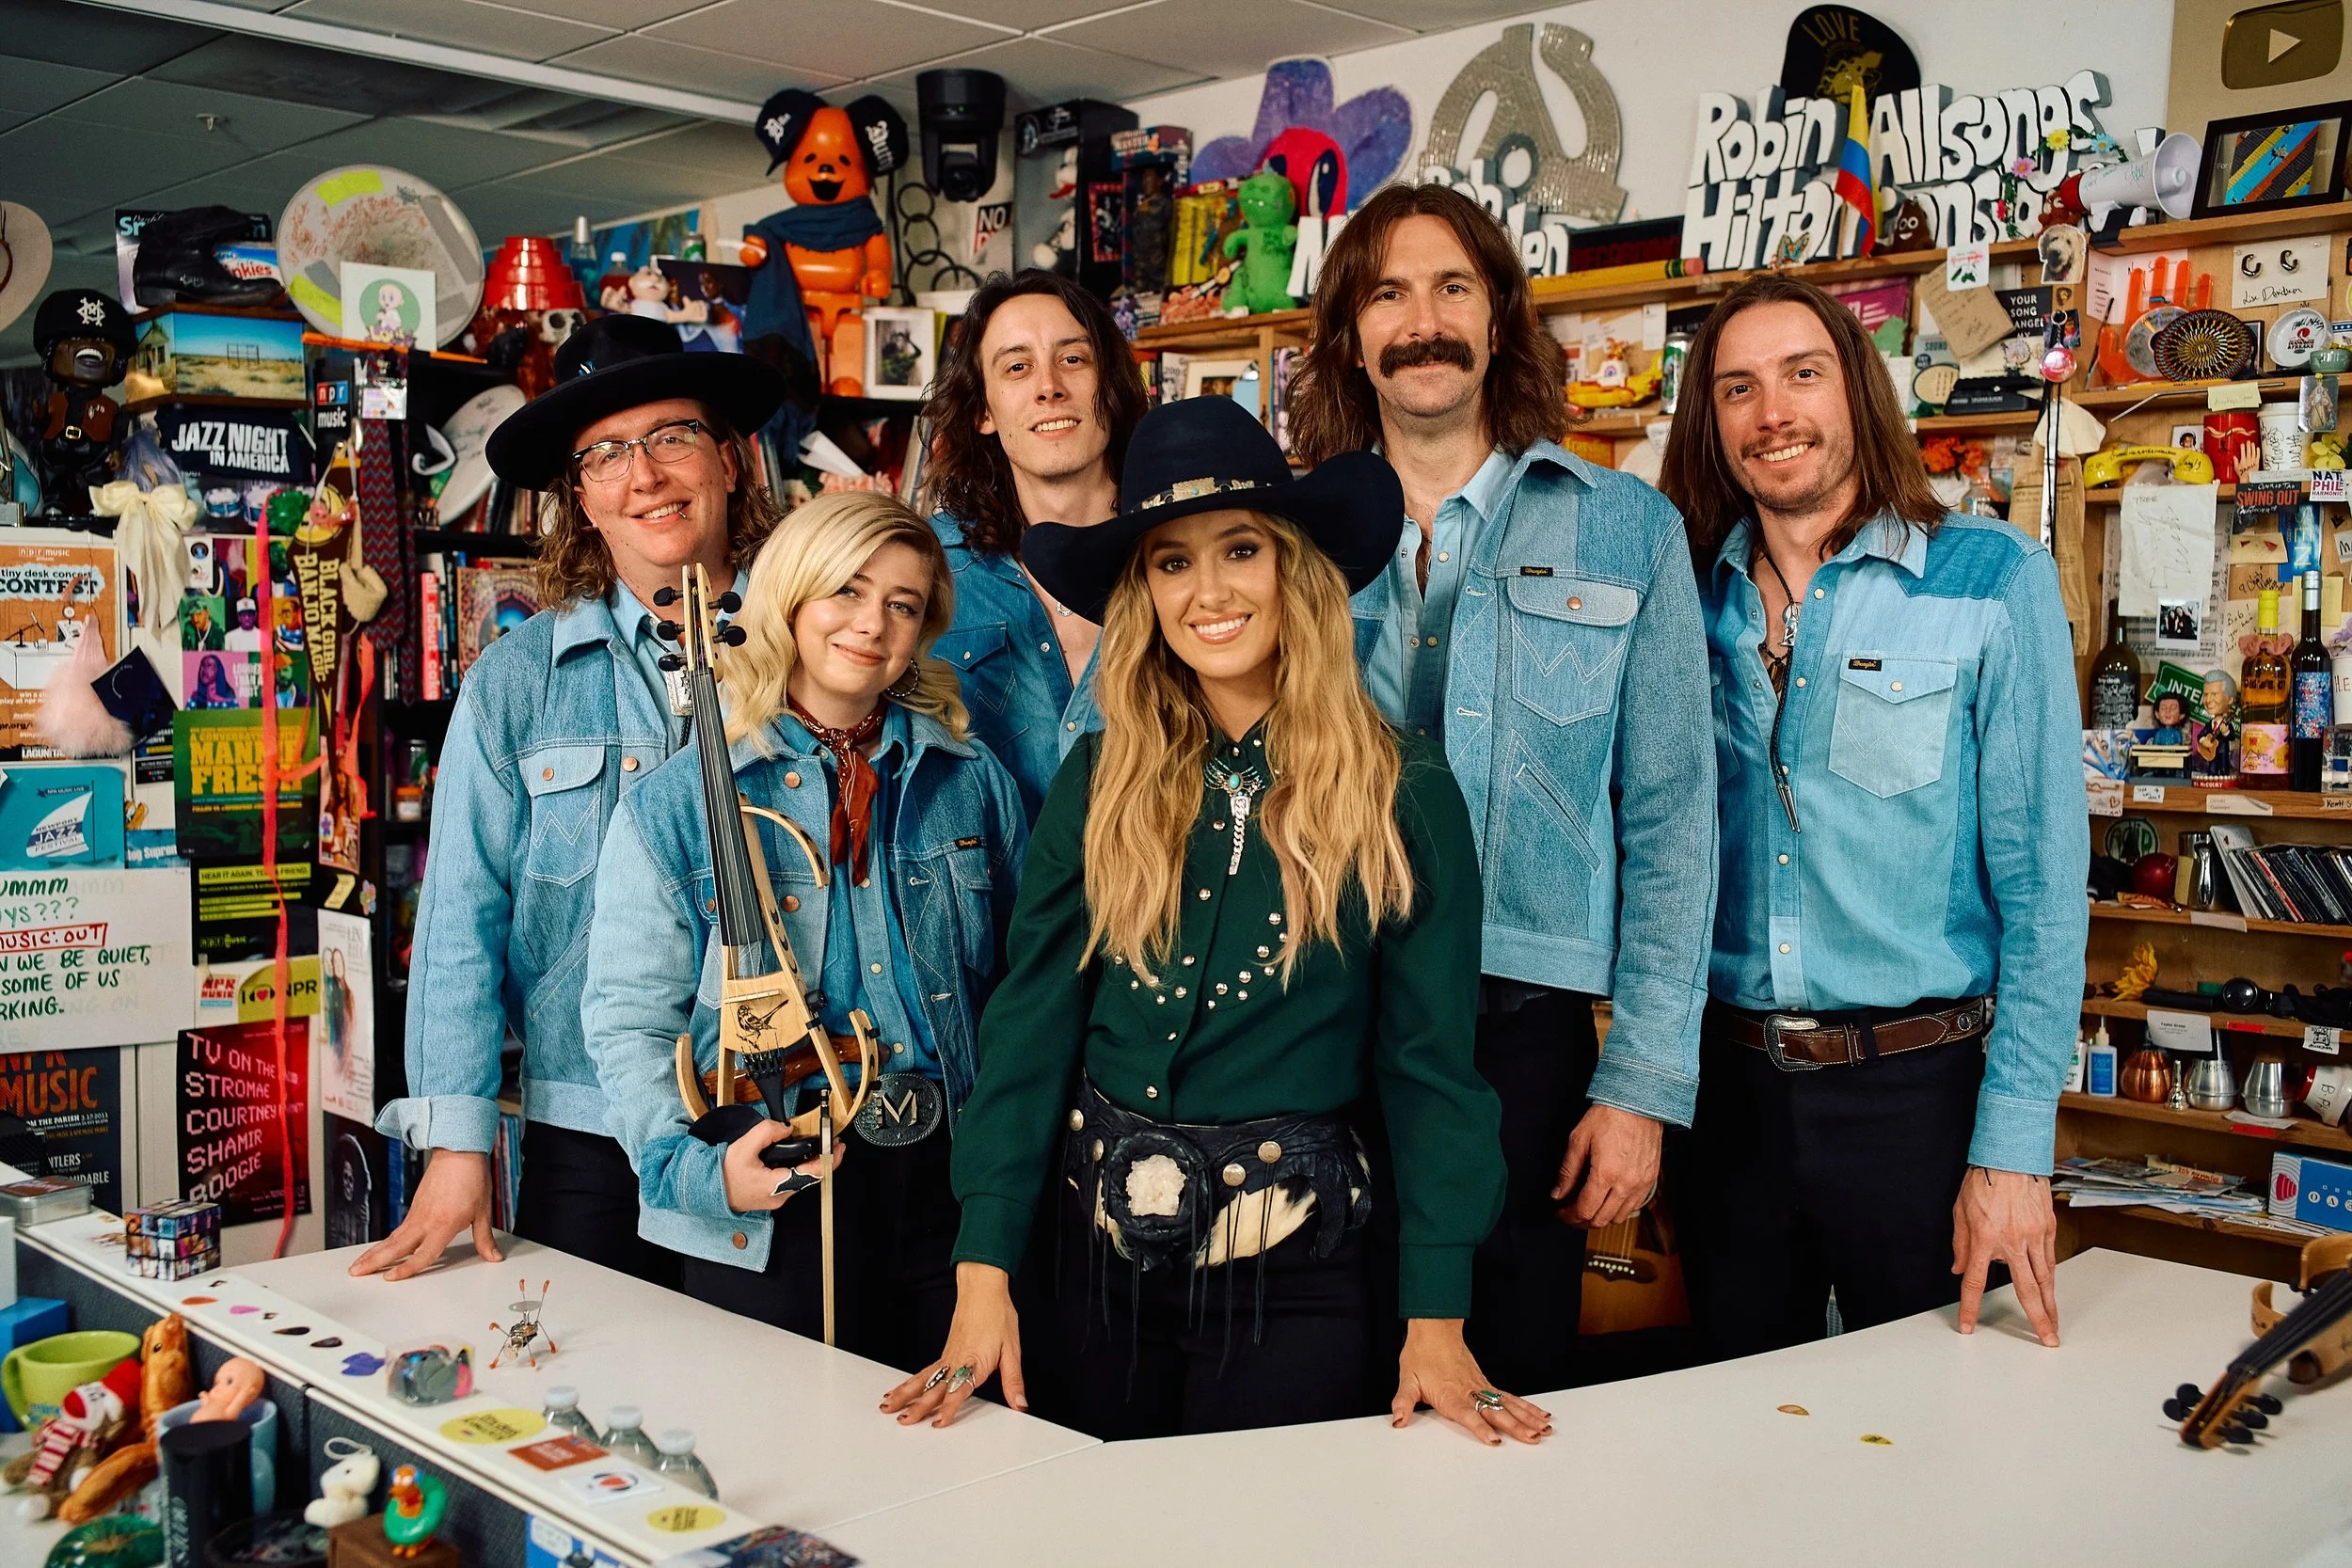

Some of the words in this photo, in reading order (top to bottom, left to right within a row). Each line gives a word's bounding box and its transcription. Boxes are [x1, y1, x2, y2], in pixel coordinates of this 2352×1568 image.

[1801, 11, 1861, 47] LOVE
[1691, 87, 1844, 185] Robin
[1873, 69, 2109, 192] Allsongs
[979, 207, 1006, 231] NO
[2010, 294, 2038, 306] YOUR
[2010, 307, 2038, 318] SONG
[318, 382, 347, 404] npr
[318, 406, 346, 429] music
[171, 421, 225, 452] JAZZ
[229, 422, 289, 457] NIGHT
[210, 450, 225, 467] IN
[227, 451, 291, 473] AMERICA
[2312, 471, 2341, 481] NAT
[2312, 482, 2344, 491] PHIL
[2236, 490, 2274, 506] SWING
[2277, 490, 2299, 506] OUT
[45, 548, 70, 557] music
[1, 569, 21, 579] tiny
[24, 570, 49, 578] desk
[293, 553, 320, 624] BANJO
[319, 557, 341, 630] BLACK
[306, 624, 327, 684] MAGIC
[321, 631, 336, 674] GIRL
[191, 763, 303, 795] FRE
[35, 825, 77, 845] JAZZ
[36, 817, 78, 832] NEWPORT
[0, 895, 80, 928] YS???
[64, 925, 103, 944] OUT
[17, 953, 46, 973] WE
[60, 949, 85, 969] BE
[97, 944, 152, 967] QUIET,
[65, 972, 90, 990] OF
[98, 969, 121, 989] US
[285, 979, 318, 997] NPR
[186, 1032, 221, 1065] TV
[229, 1049, 252, 1072] ON
[256, 1058, 276, 1080] THE
[0, 1066, 99, 1117] MUSIC
[185, 1071, 271, 1099] STROMAE
[39, 1118, 53, 1127] THE
[55, 1115, 80, 1125] PARISH
[185, 1103, 277, 1135] COURTNEY
[873, 1088, 920, 1130] M
[186, 1128, 262, 1175] SHAMIR
[189, 1151, 262, 1203] BOOGIE
